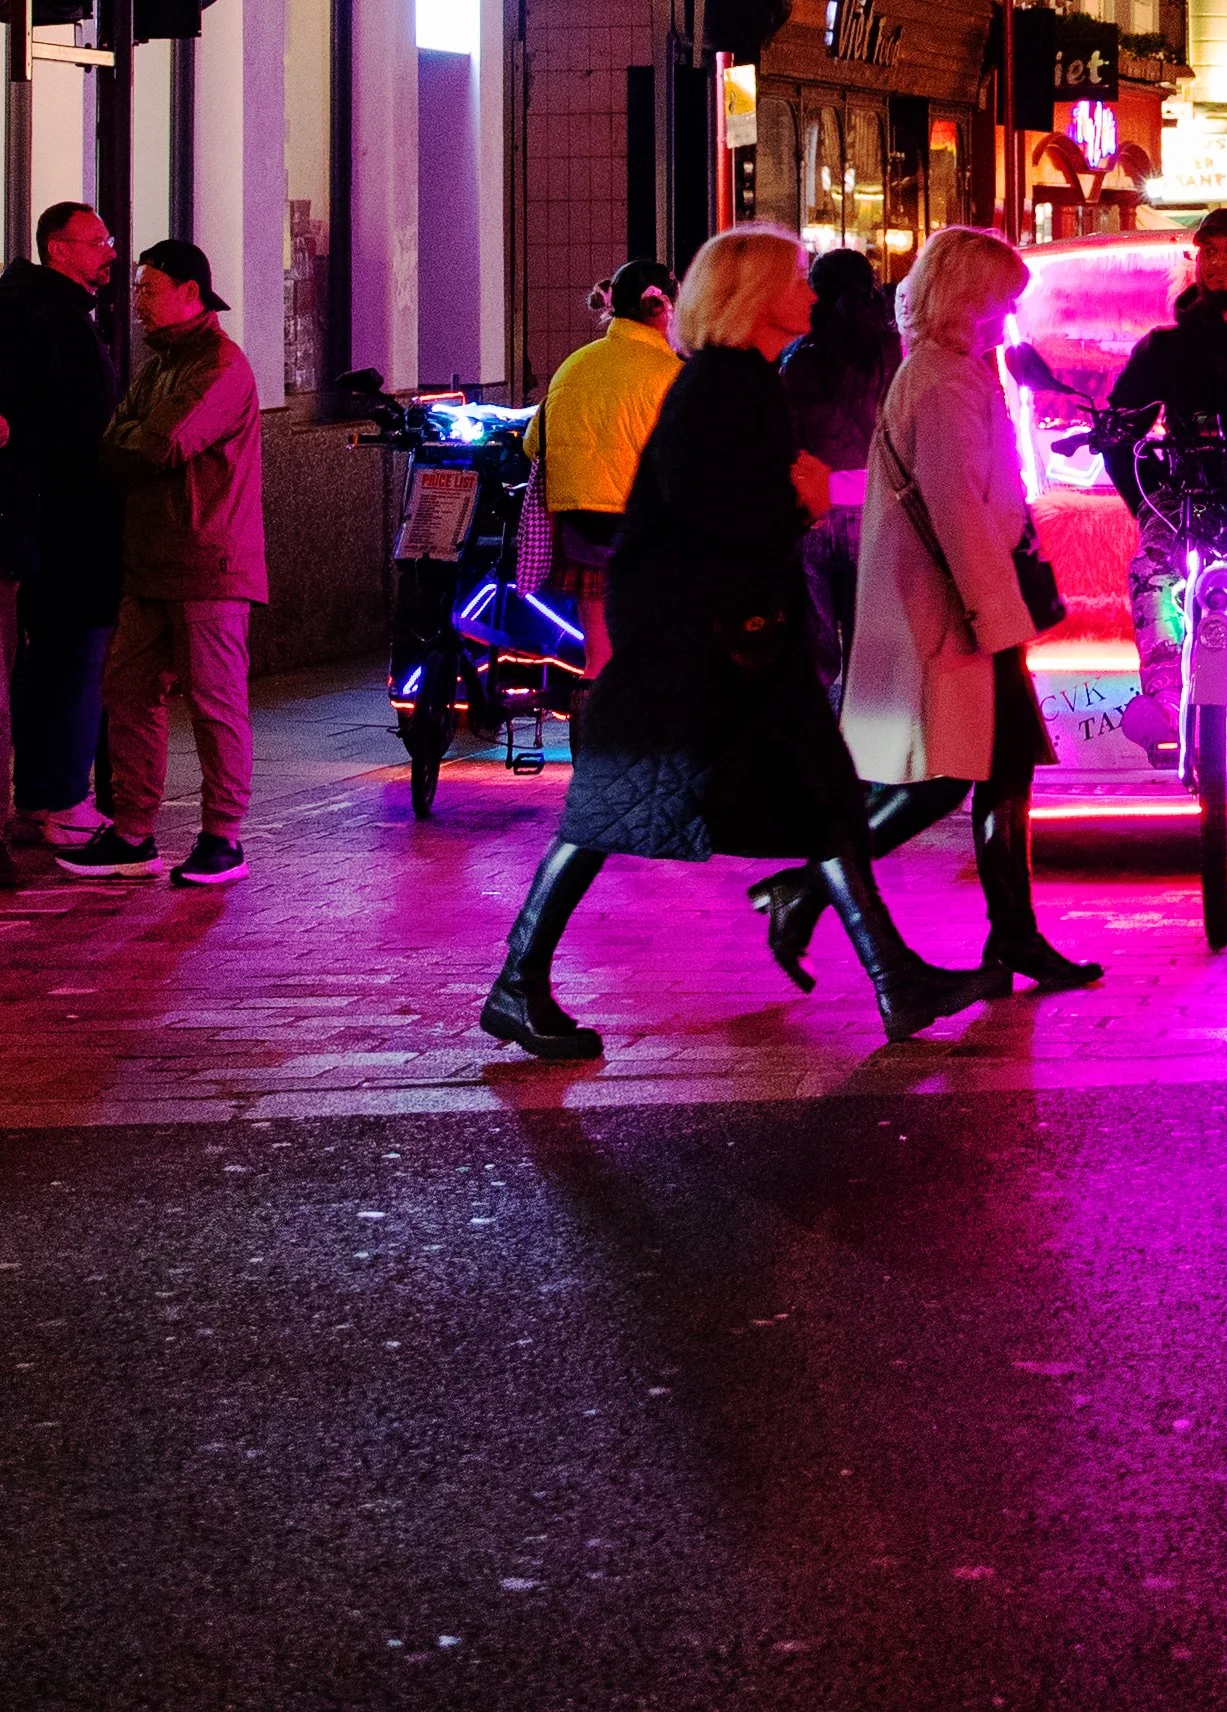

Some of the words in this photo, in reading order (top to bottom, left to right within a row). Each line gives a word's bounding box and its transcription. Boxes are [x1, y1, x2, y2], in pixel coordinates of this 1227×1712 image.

[1054, 49, 1110, 88] iet
[422, 473, 452, 488] PRICE
[454, 475, 475, 489] LIST
[1078, 703, 1128, 742] TAX
